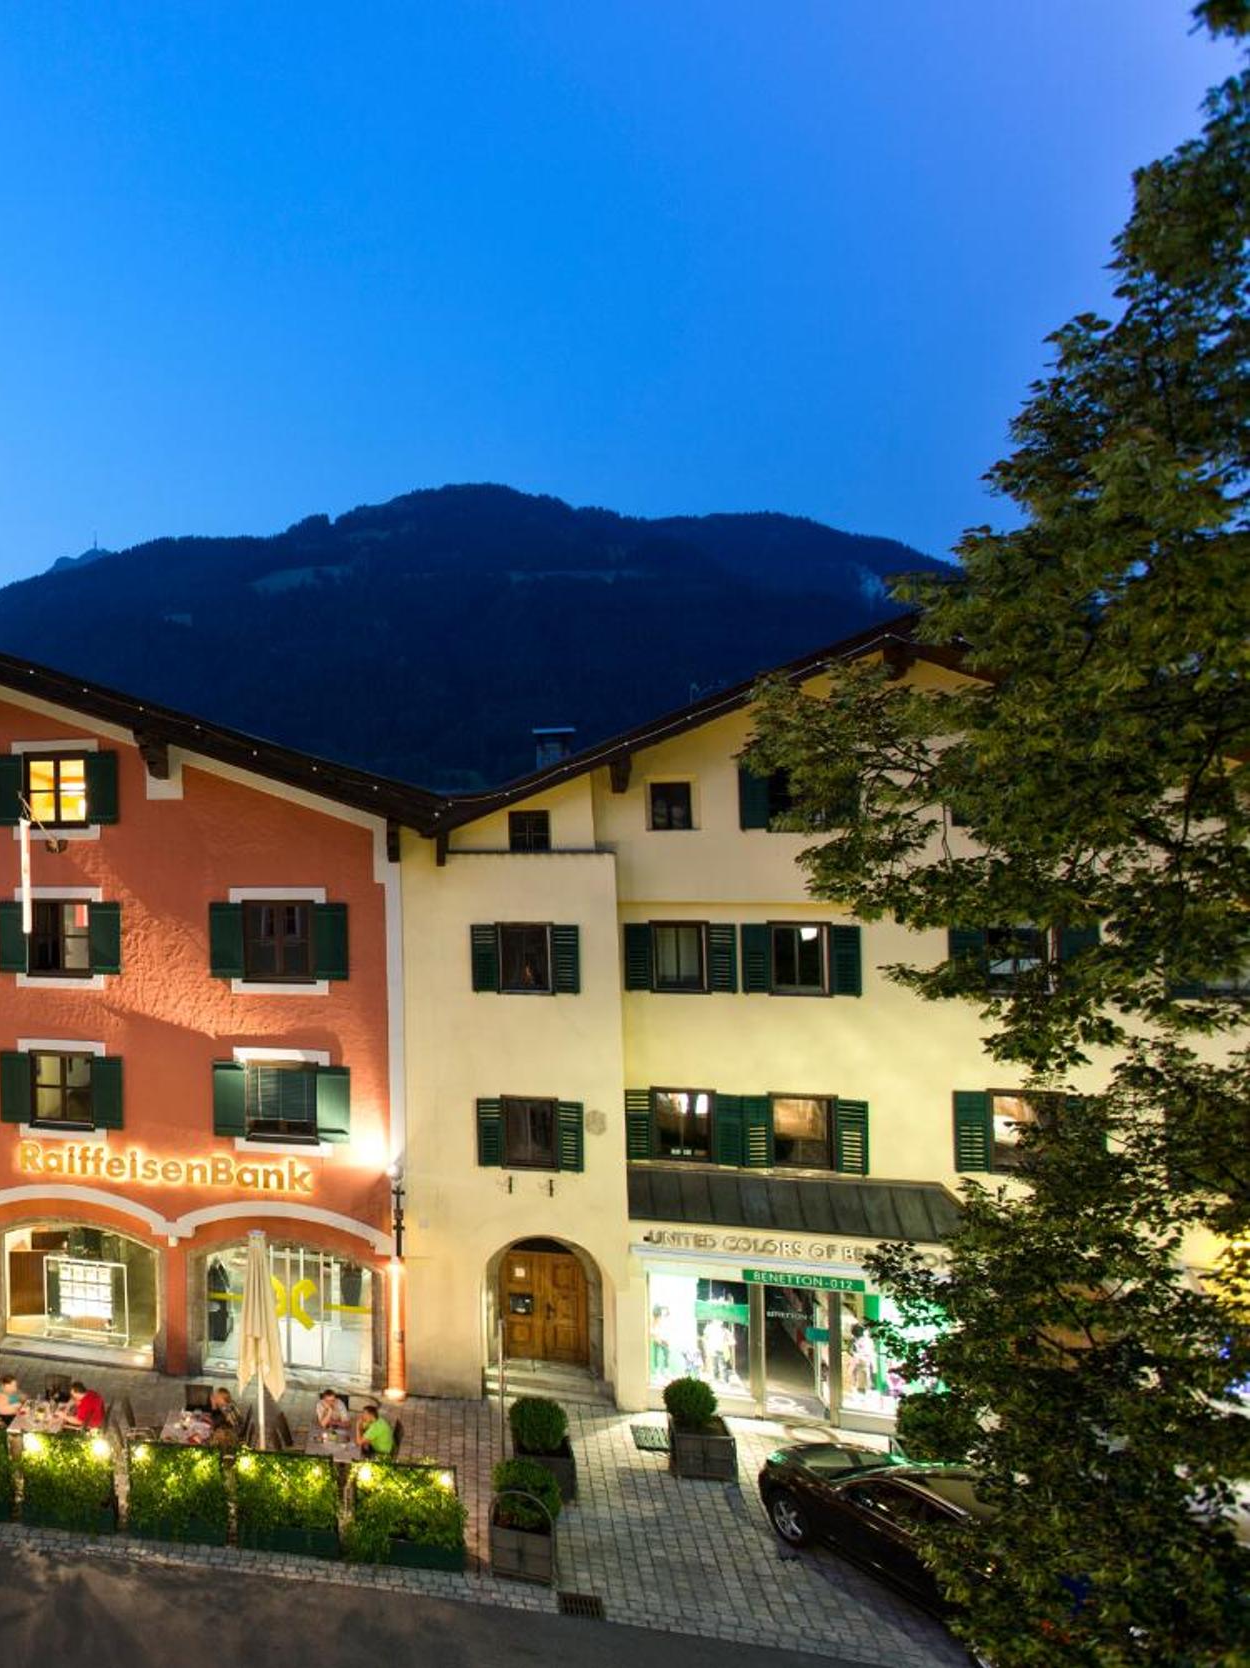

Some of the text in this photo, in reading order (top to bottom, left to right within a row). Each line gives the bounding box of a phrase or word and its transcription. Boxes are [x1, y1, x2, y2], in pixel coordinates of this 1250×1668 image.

[19, 1142, 312, 1192] RaiffeisenBank
[649, 1230, 716, 1249] UNITED
[723, 1236, 802, 1256] COLORS
[808, 1242, 837, 1261] OF
